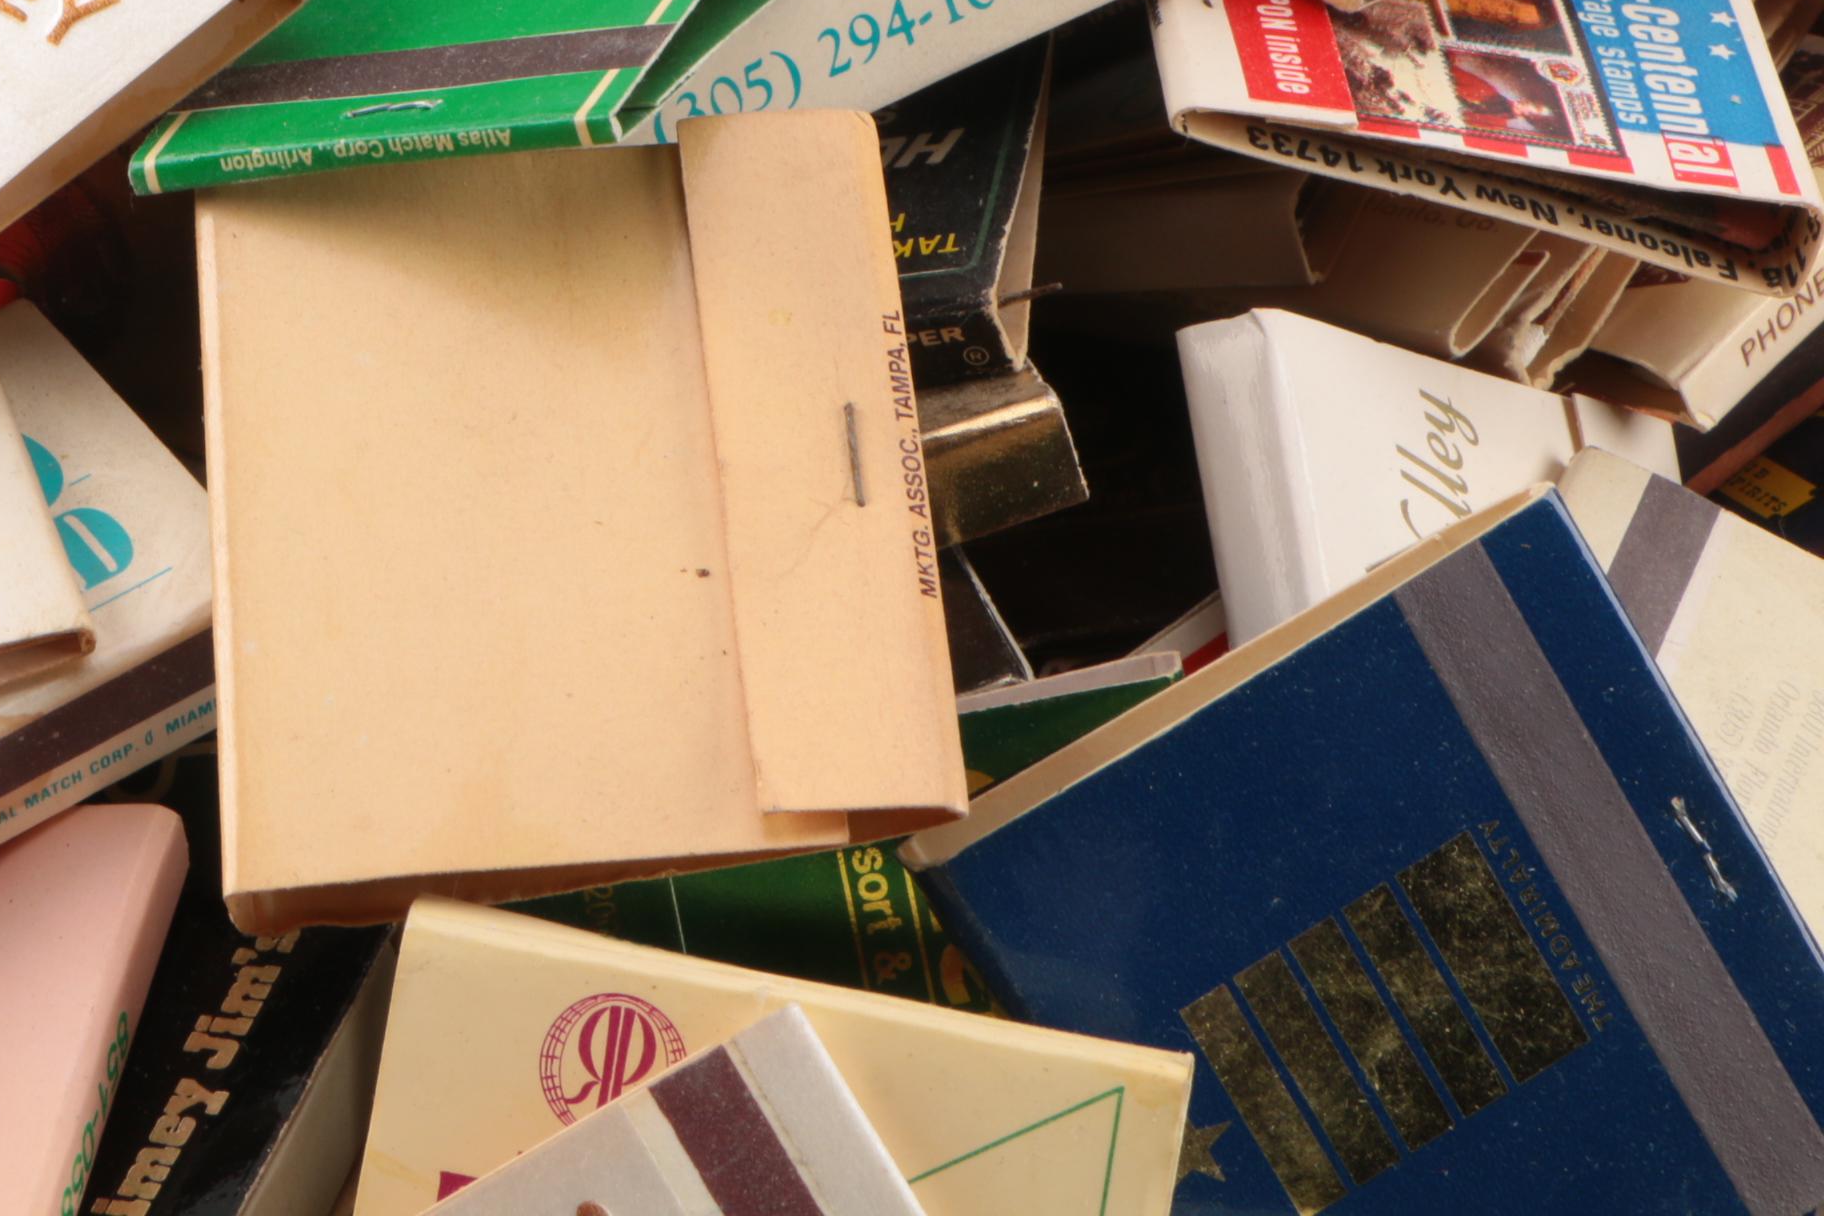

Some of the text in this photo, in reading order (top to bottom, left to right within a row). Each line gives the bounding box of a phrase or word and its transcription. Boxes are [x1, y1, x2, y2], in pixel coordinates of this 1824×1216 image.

[1276, 33, 1312, 96] inside
[1598, 44, 1649, 126] stamps
[219, 126, 512, 174] Atlas Match Arlington
[1245, 122, 1363, 177] 14733
[1379, 158, 1470, 204] York
[1473, 182, 1559, 229] New
[882, 309, 940, 600] MKTG. ASSOC., TAMPA, FL
[23, 768, 85, 812] MATCH
[88, 740, 142, 777] CORP.
[1476, 816, 1616, 1035] THE ADMIRALTY
